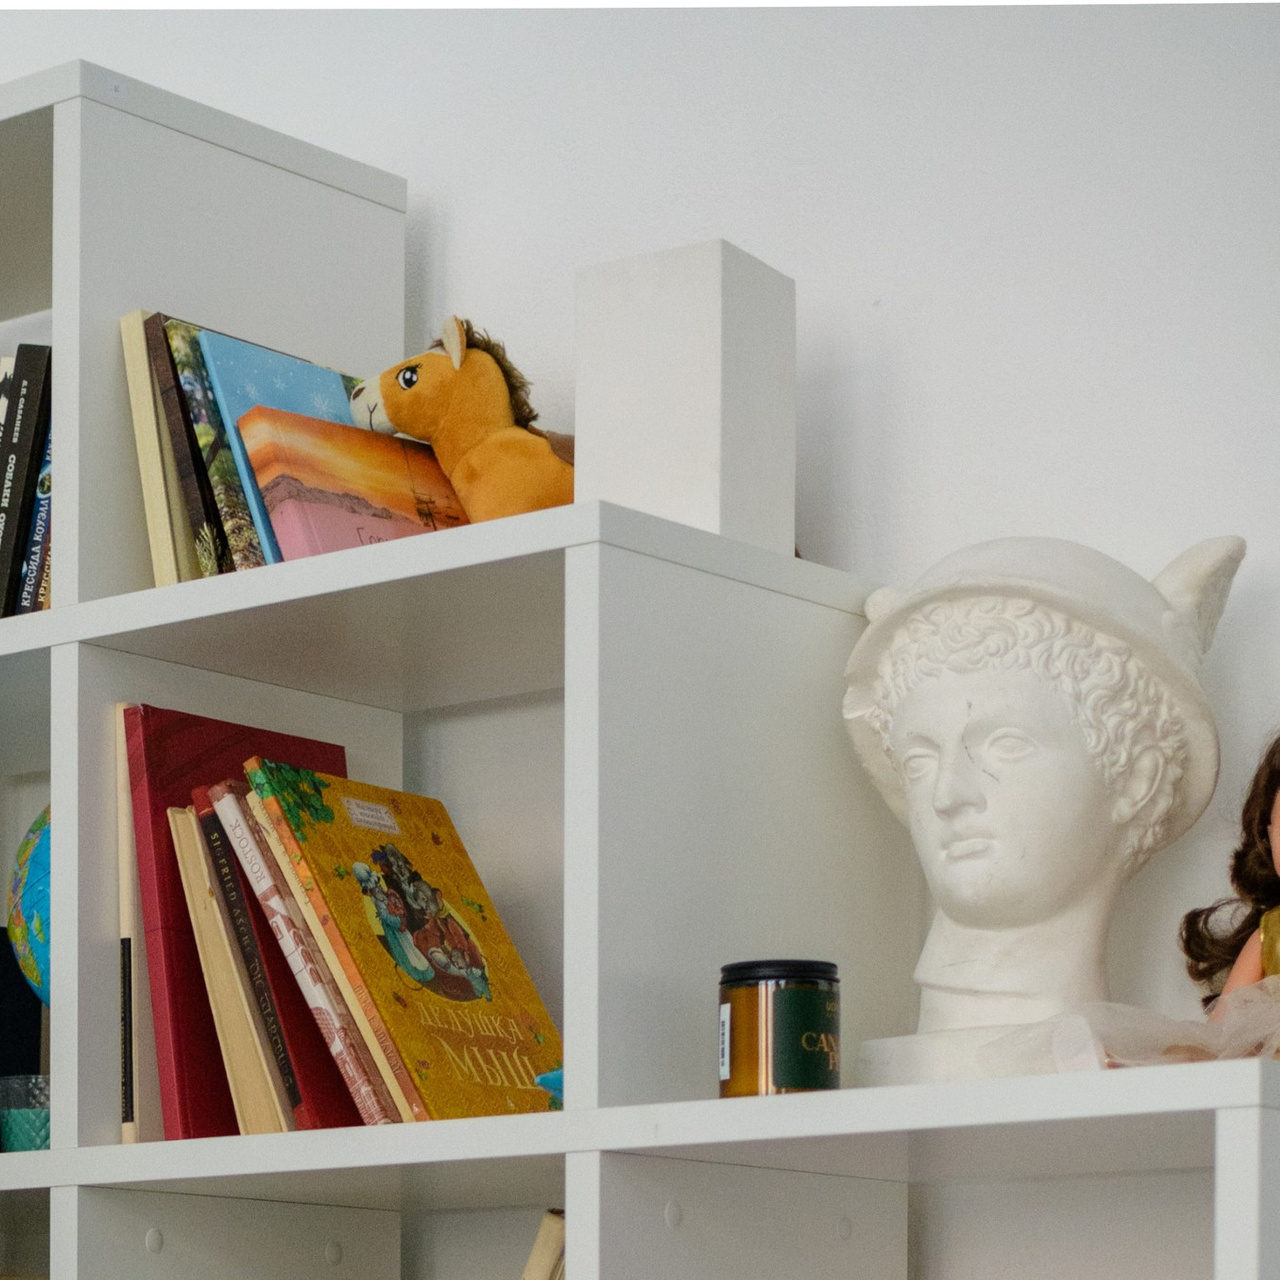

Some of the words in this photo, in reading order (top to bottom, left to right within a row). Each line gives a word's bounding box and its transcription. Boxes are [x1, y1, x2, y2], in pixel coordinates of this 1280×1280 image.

[1, 453, 17, 507] СОБАКИ
[21, 545, 41, 607] КРЕССИДА
[33, 499, 49, 542] КОУЭЛЛ
[210, 832, 238, 901] SIGFRIED
[229, 818, 266, 883] ROSTOCK
[417, 1001, 524, 1045] ДЕДУШКА
